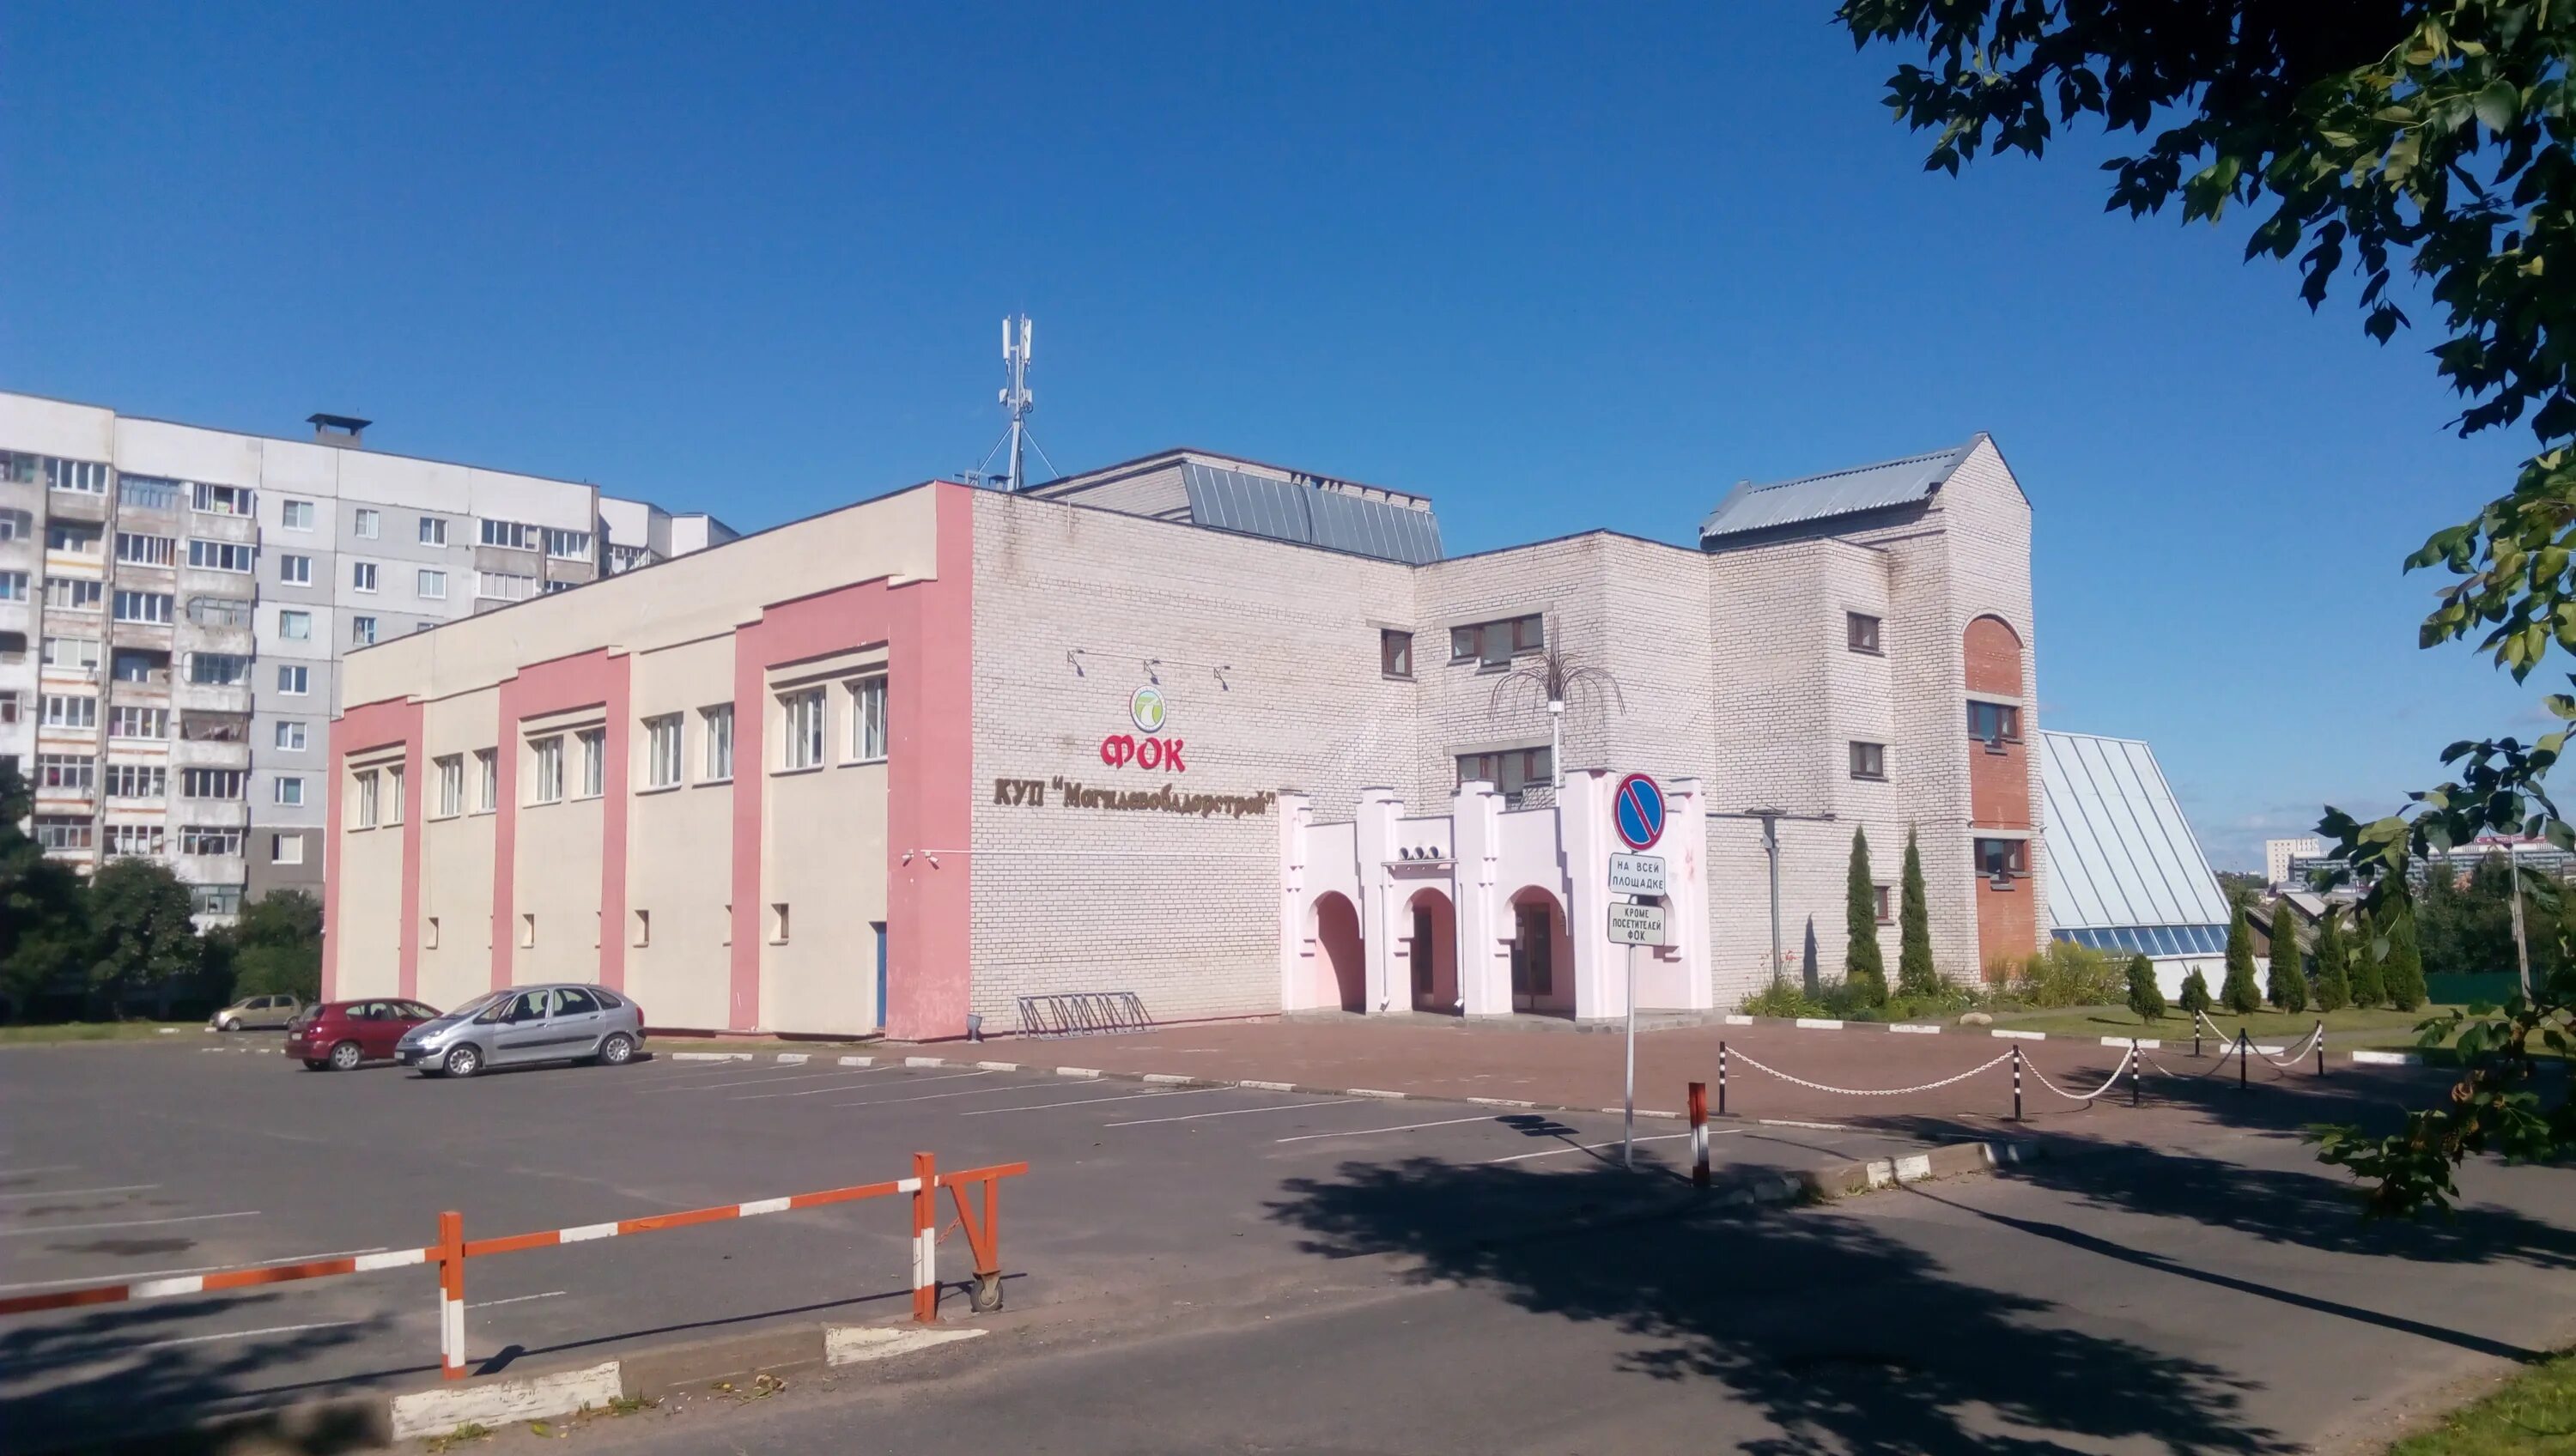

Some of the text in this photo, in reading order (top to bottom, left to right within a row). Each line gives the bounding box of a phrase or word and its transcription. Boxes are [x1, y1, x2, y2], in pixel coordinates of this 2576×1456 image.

[1100, 734, 1185, 773] ФОК
[993, 778, 1044, 807] КУП
[1617, 861, 1659, 873] НА ВСЕЙ
[1613, 877, 1663, 889] ПЛОЩАДКЕ
[1624, 908, 1649, 918] КРОМЕ
[1612, 919, 1661, 930] ПОСЕТИТЕЛЕЙ
[1627, 930, 1645, 941] ФОК
